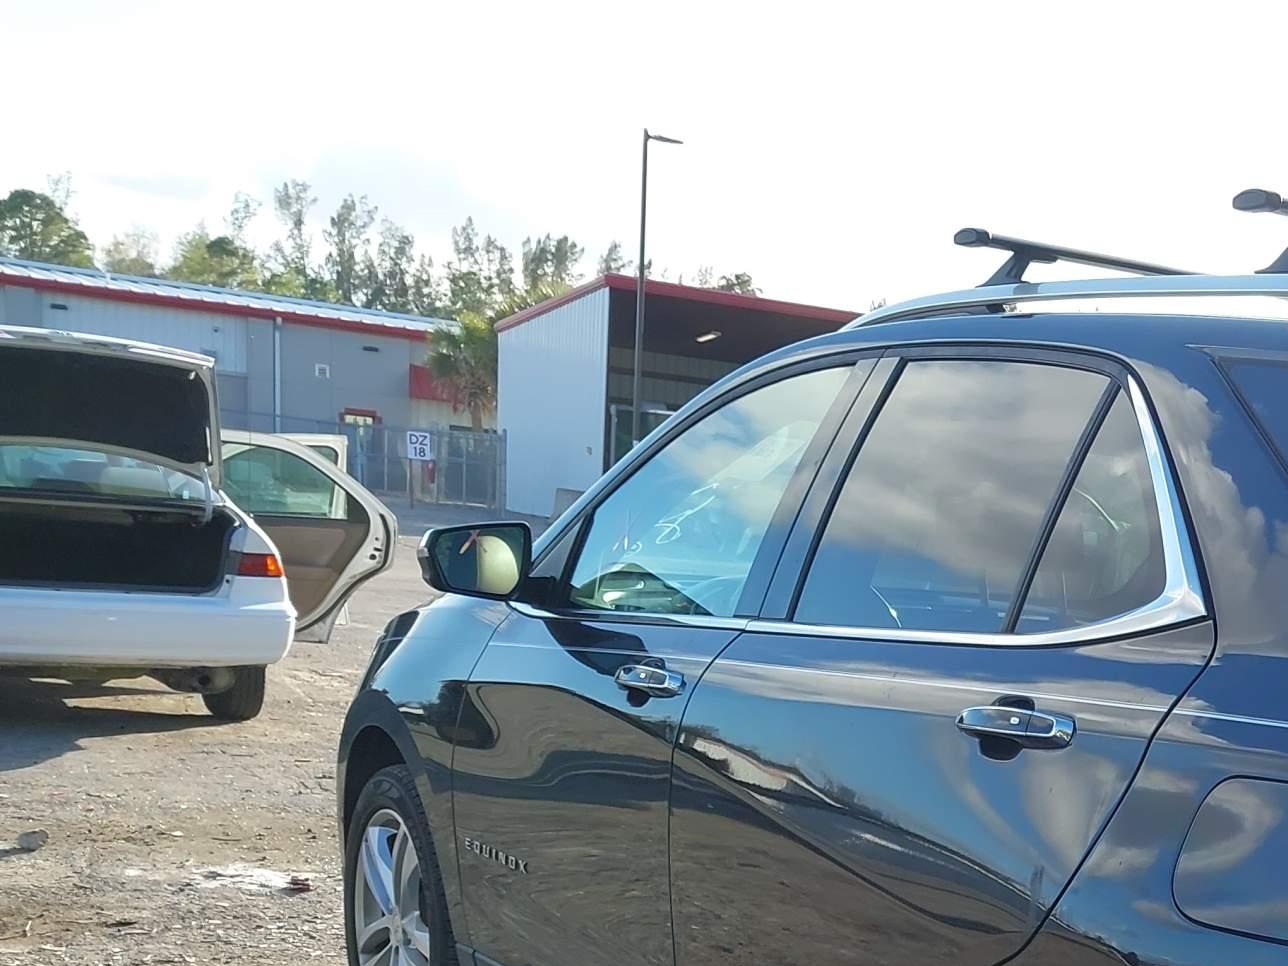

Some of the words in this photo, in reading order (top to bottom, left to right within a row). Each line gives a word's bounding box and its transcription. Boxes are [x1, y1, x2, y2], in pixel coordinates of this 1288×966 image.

[409, 433, 428, 446] DZ
[413, 446, 426, 458] 18
[464, 837, 528, 874] EQUINOX
